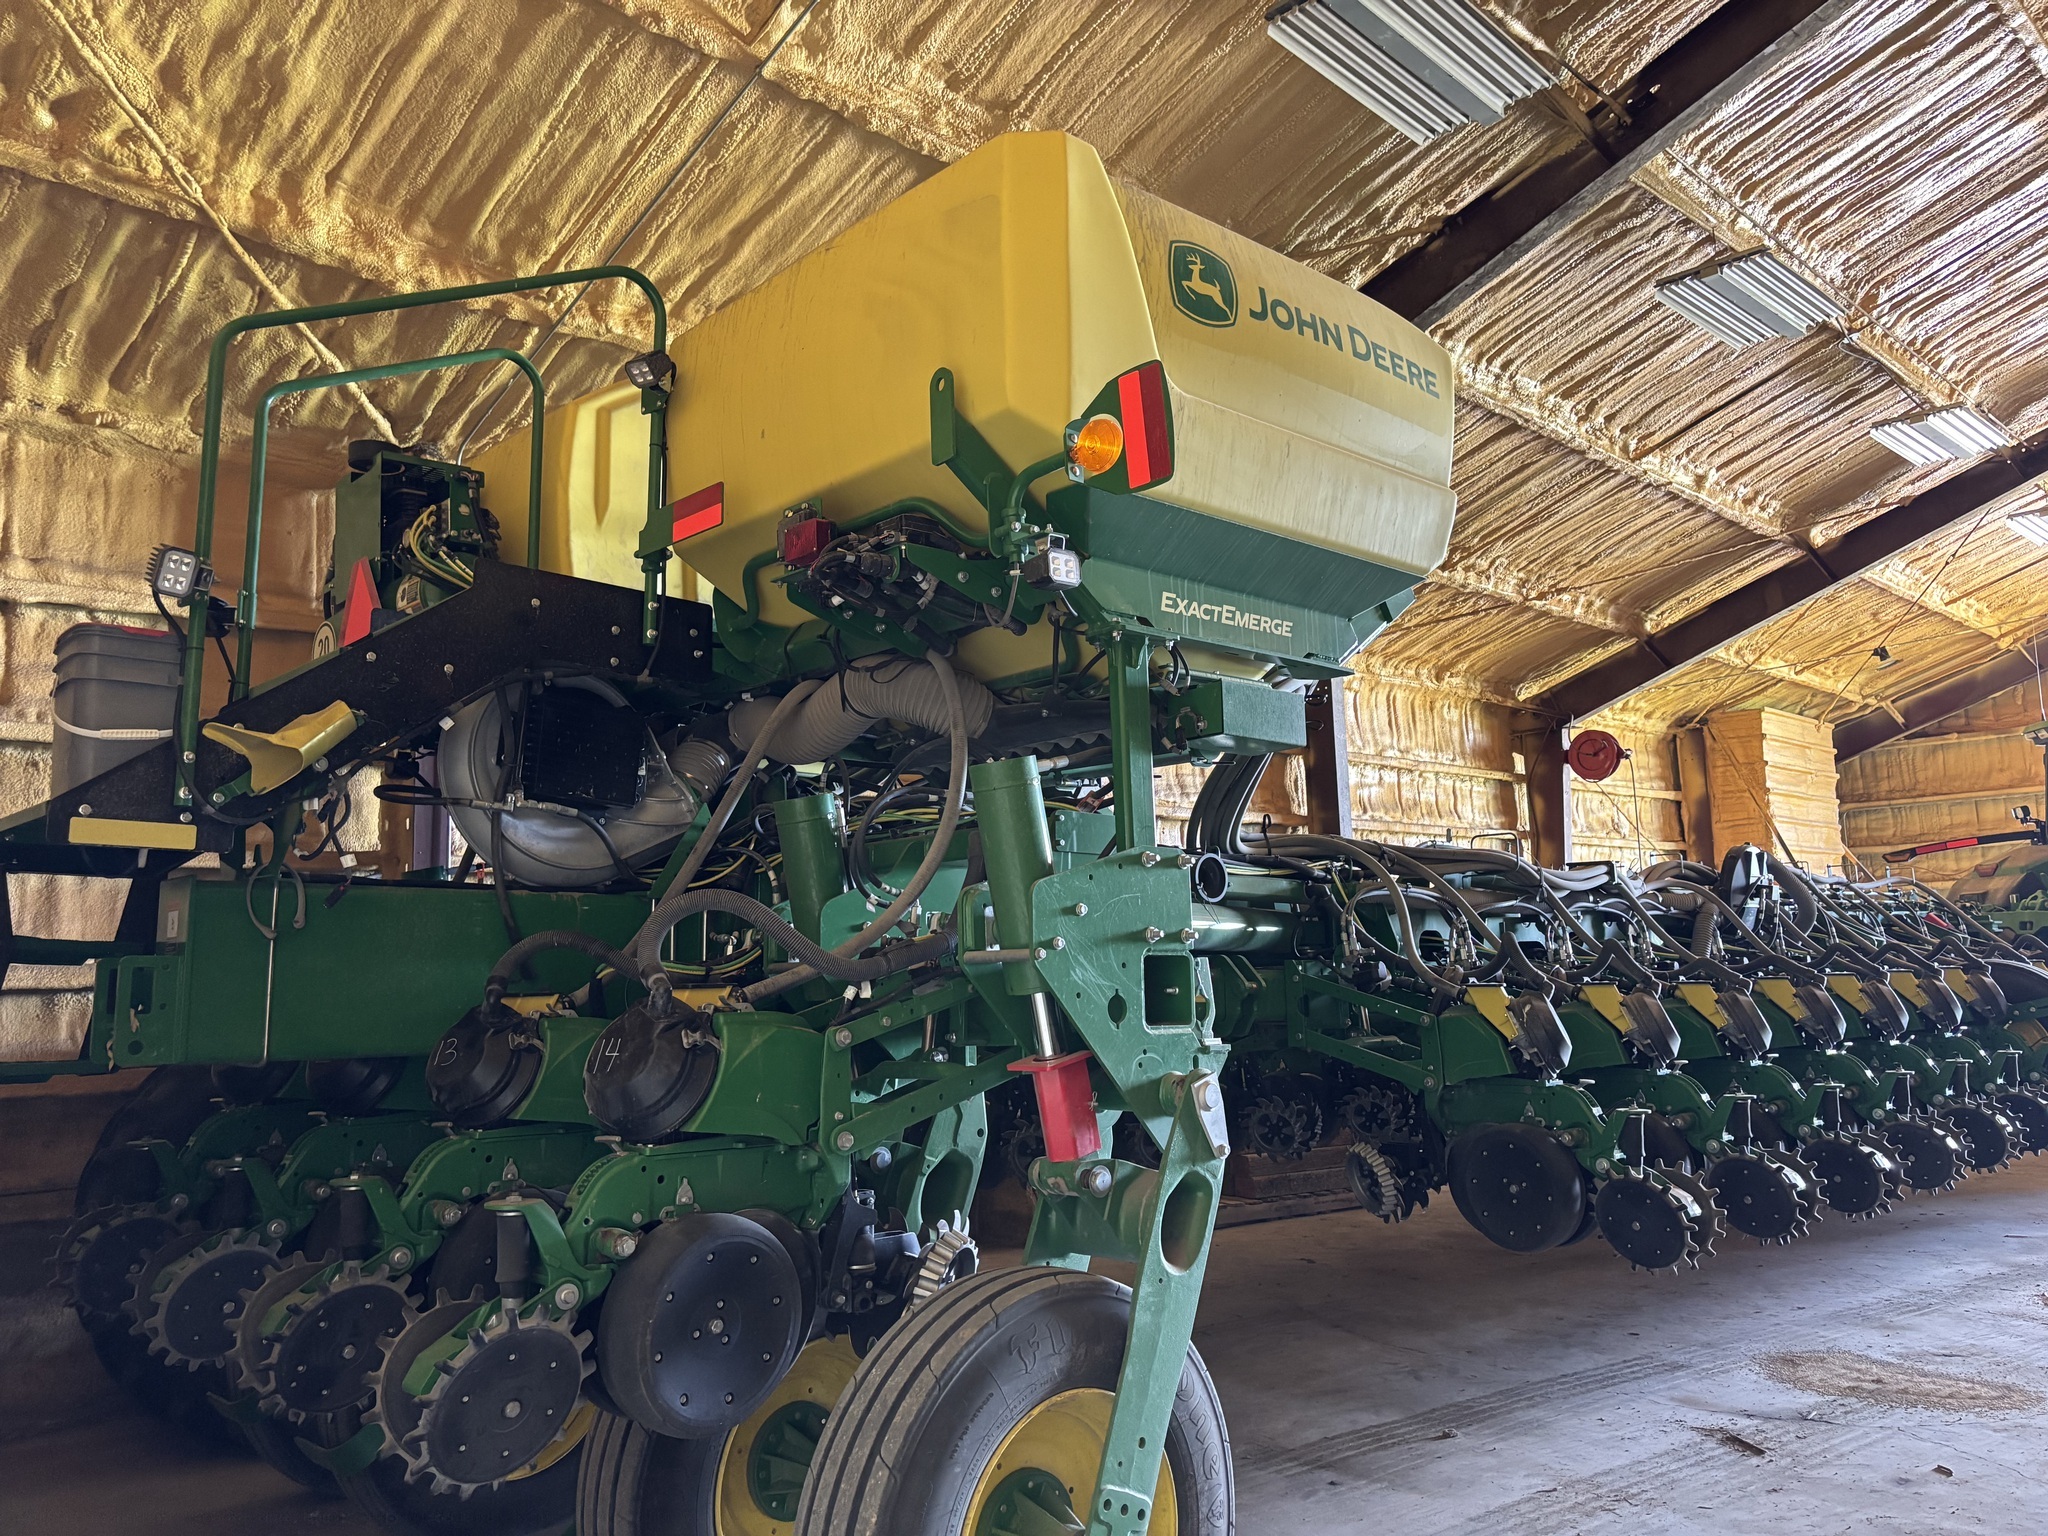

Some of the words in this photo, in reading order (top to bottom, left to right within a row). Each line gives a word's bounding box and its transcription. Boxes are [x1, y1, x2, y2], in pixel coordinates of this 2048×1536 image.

[1249, 286, 1344, 352] JOHN
[1346, 324, 1440, 400] DEERE
[433, 1037, 458, 1066] 13
[592, 1037, 621, 1075] 14
